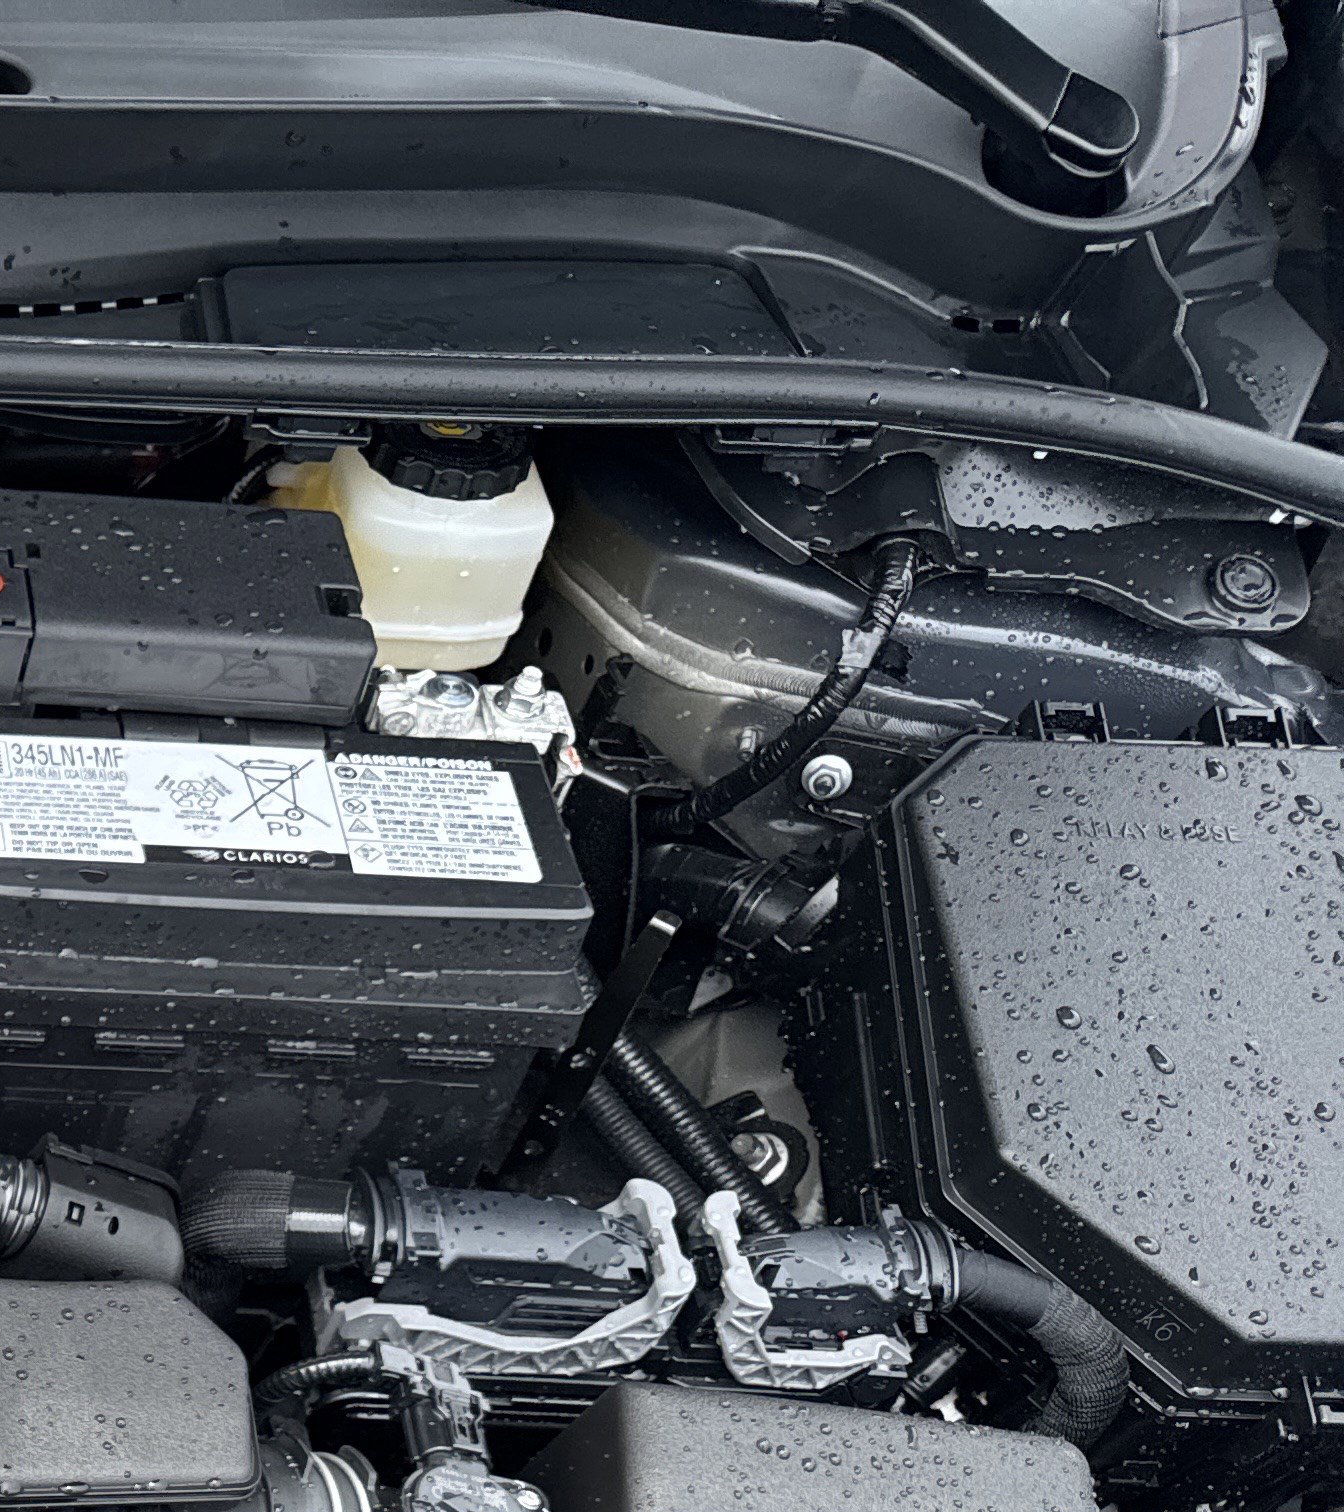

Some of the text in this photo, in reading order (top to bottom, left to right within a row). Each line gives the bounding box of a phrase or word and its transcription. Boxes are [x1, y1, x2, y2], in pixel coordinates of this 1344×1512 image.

[11, 742, 125, 769] 345LN1-MF
[349, 753, 492, 771] DANGER/POISON
[267, 821, 303, 838] Pb
[223, 850, 309, 865] CLARIOS
